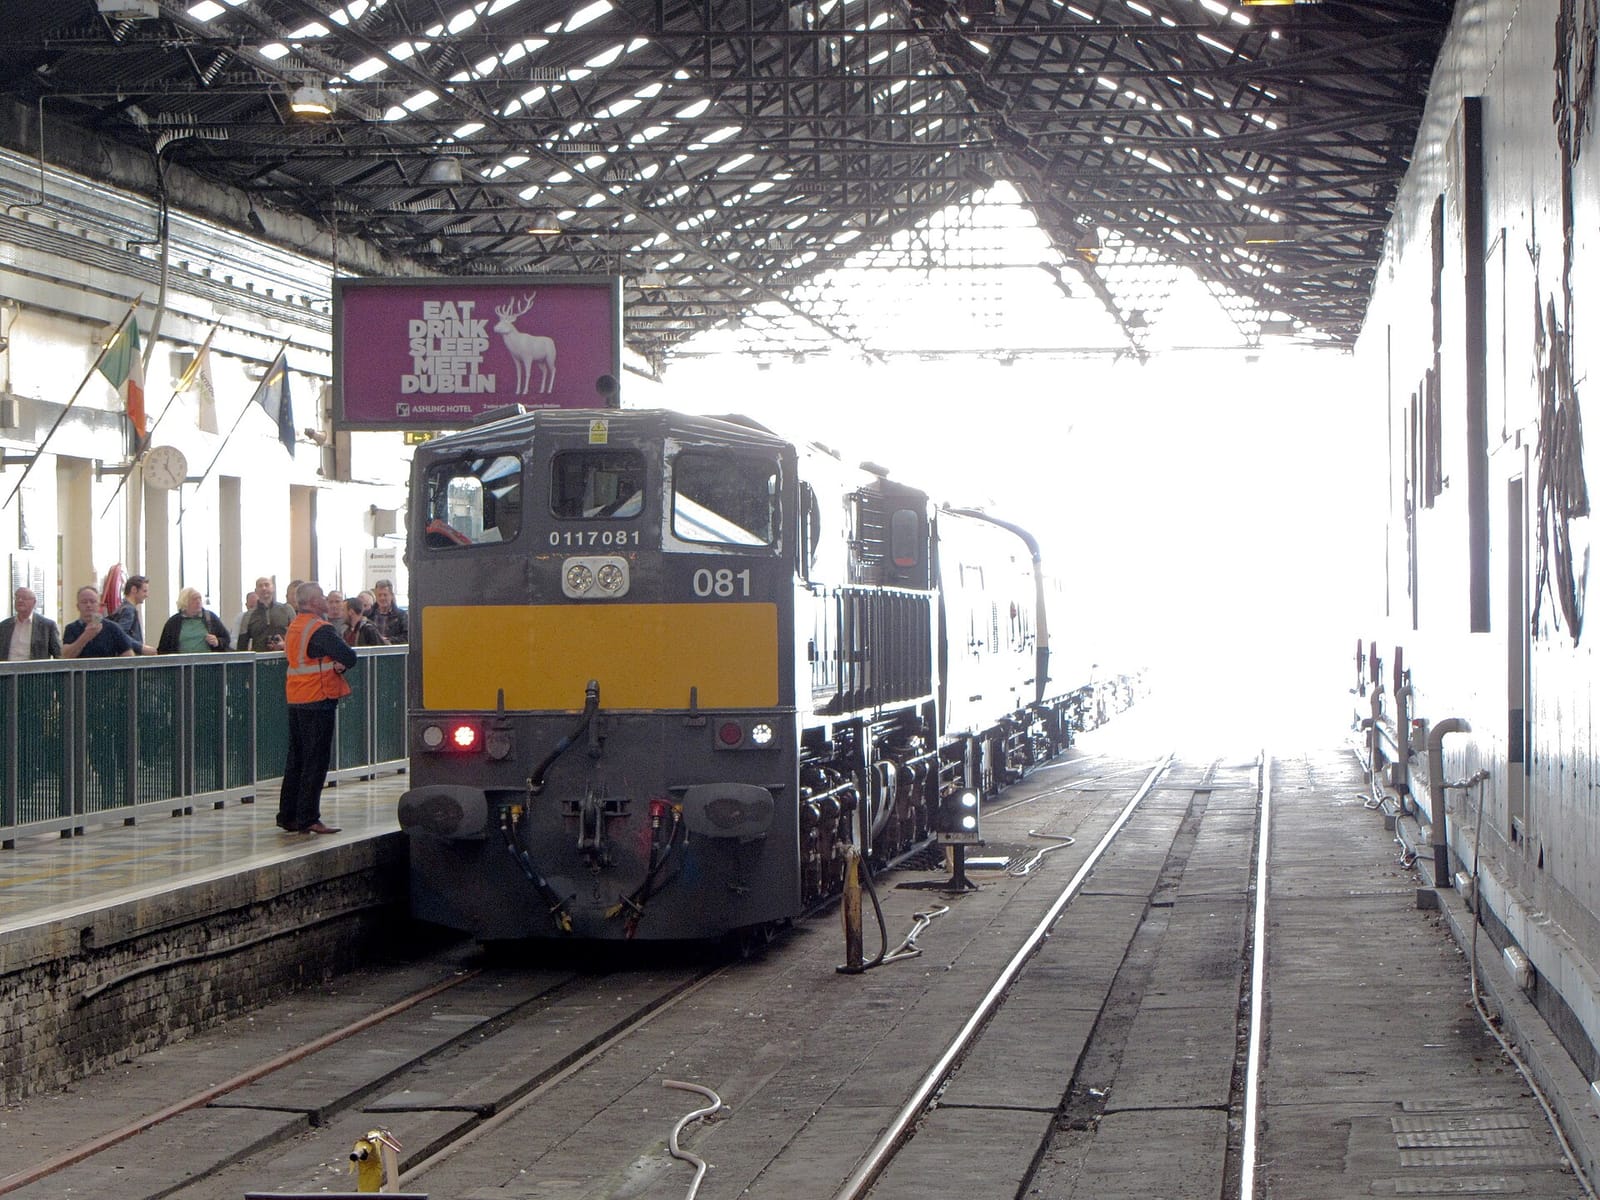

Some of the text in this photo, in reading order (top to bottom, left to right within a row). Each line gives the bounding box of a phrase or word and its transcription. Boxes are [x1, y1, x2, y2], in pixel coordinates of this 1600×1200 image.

[423, 301, 476, 320] EAT
[408, 319, 489, 338] DRINK
[408, 337, 490, 357] SLEEP
[413, 356, 484, 375] MEET
[401, 374, 496, 394] DUBLIN
[411, 404, 446, 413] ASHLING
[446, 404, 473, 413] HOTEL
[549, 530, 640, 546] 0117081
[693, 568, 751, 598] 081
